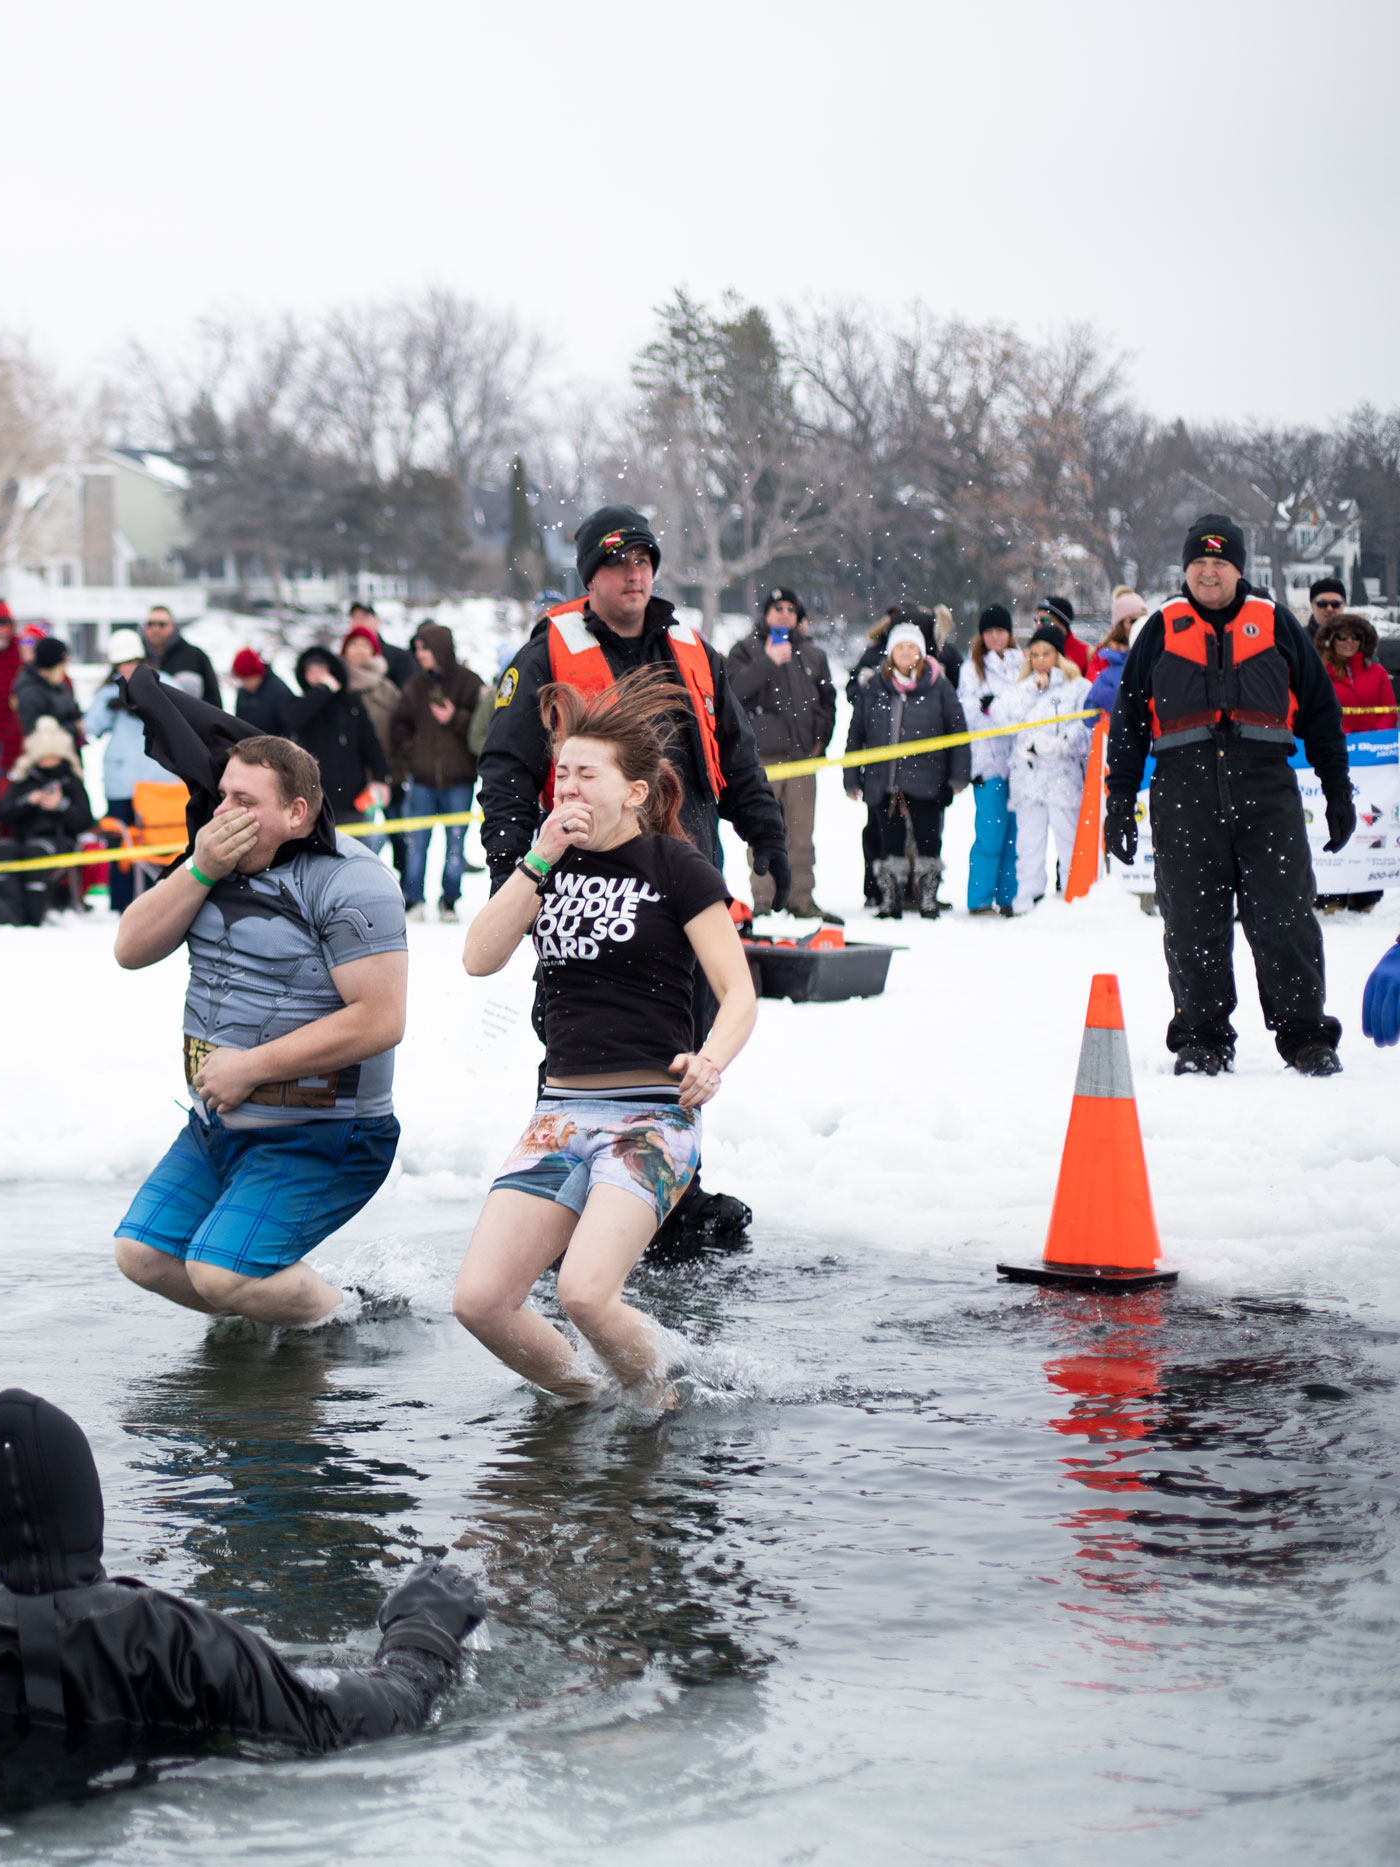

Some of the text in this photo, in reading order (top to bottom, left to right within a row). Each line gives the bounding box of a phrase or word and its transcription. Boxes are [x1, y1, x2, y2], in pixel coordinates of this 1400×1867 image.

[554, 871, 661, 902] WOULD
[543, 892, 640, 920] UDDLE
[535, 913, 636, 943] OU SO
